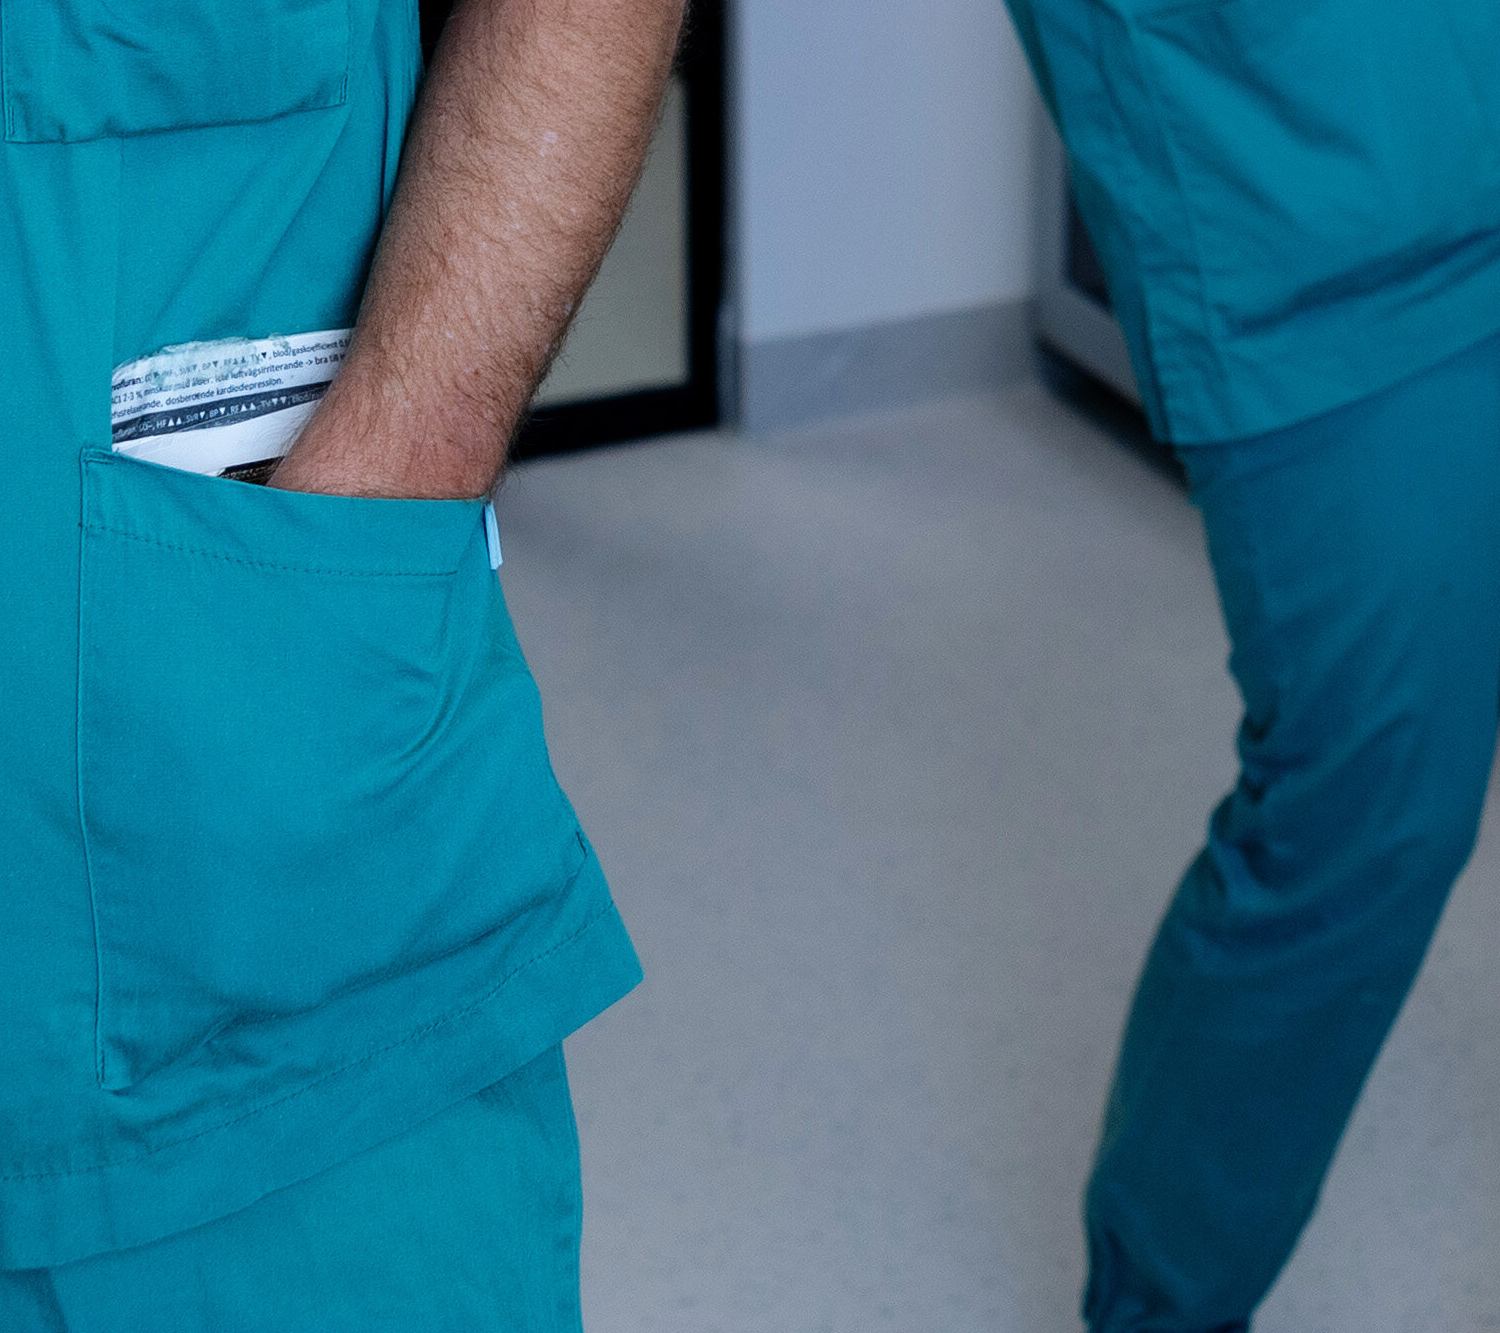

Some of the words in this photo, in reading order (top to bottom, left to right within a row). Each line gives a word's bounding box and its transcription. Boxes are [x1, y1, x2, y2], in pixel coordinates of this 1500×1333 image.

[123, 390, 134, 402] 2-3
[314, 357, 328, 365] bra
[166, 389, 214, 406] dosberoende
[216, 377, 284, 395] kardiodepression.
